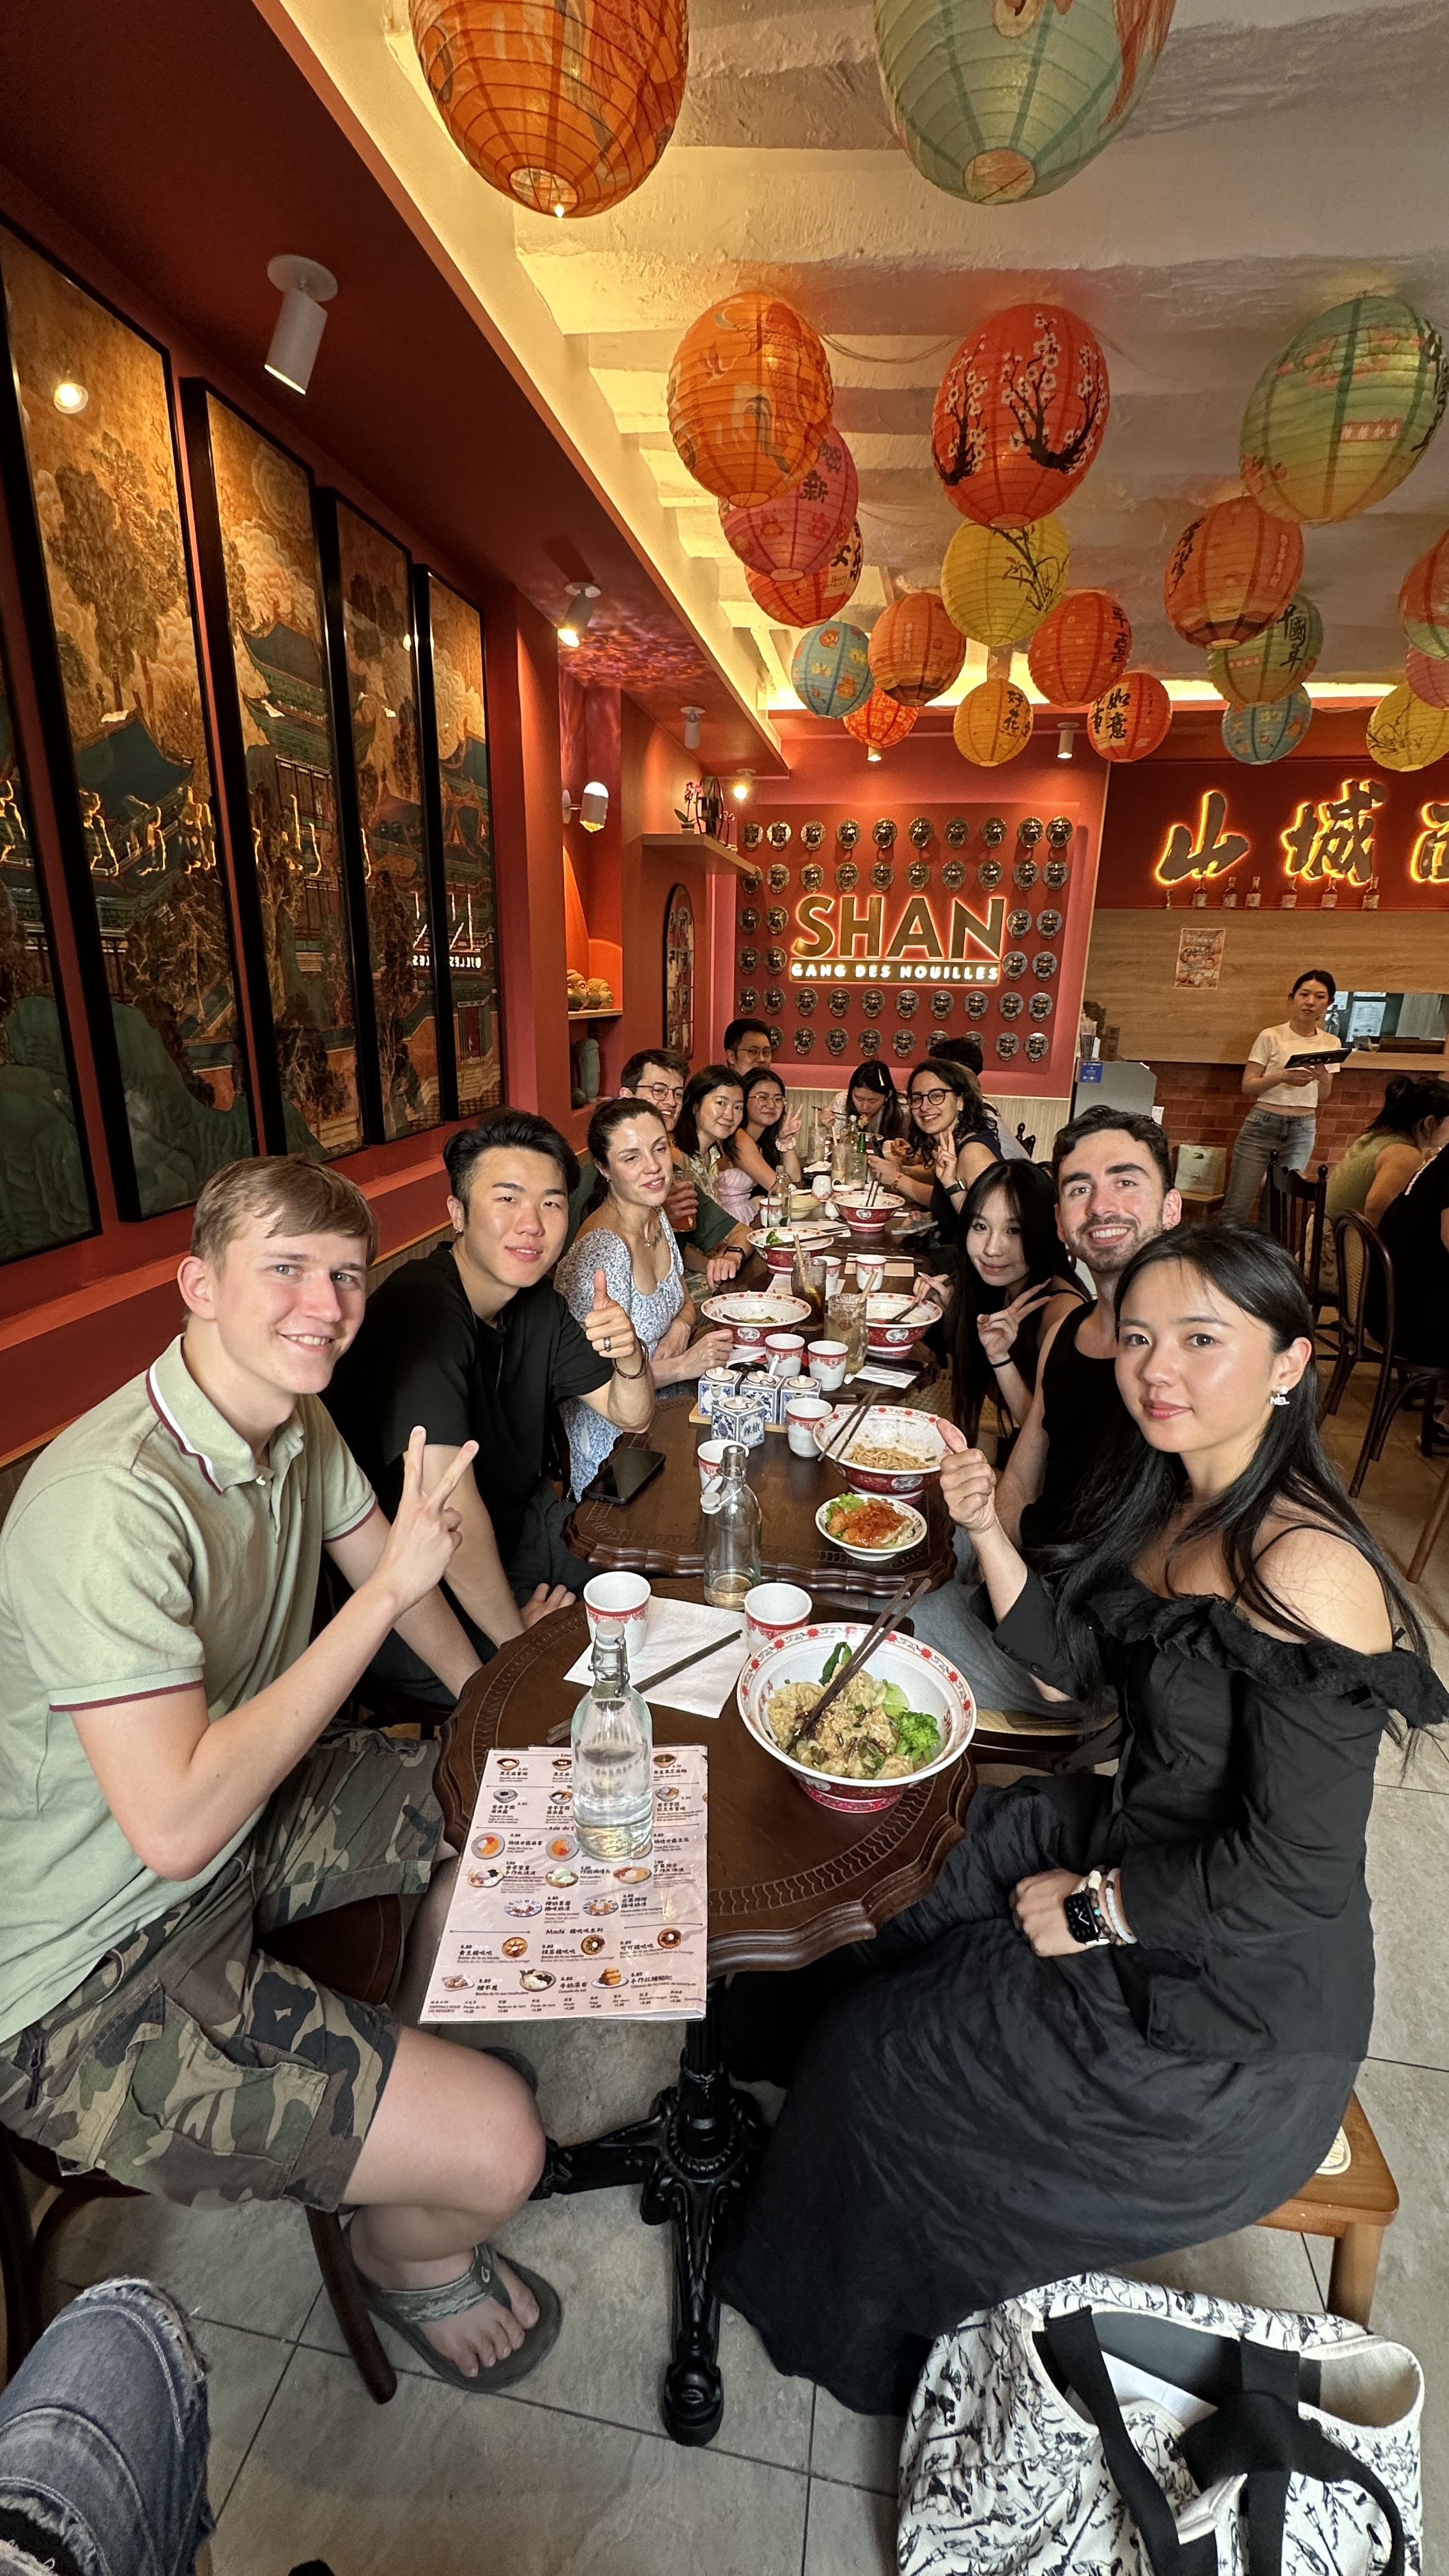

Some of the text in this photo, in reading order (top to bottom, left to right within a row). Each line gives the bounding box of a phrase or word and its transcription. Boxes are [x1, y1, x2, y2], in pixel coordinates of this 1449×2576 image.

[1107, 688, 1131, 739] 如意
[792, 896, 1005, 959] SHAN
[791, 963, 999, 981] GANG DES NOUILLES
